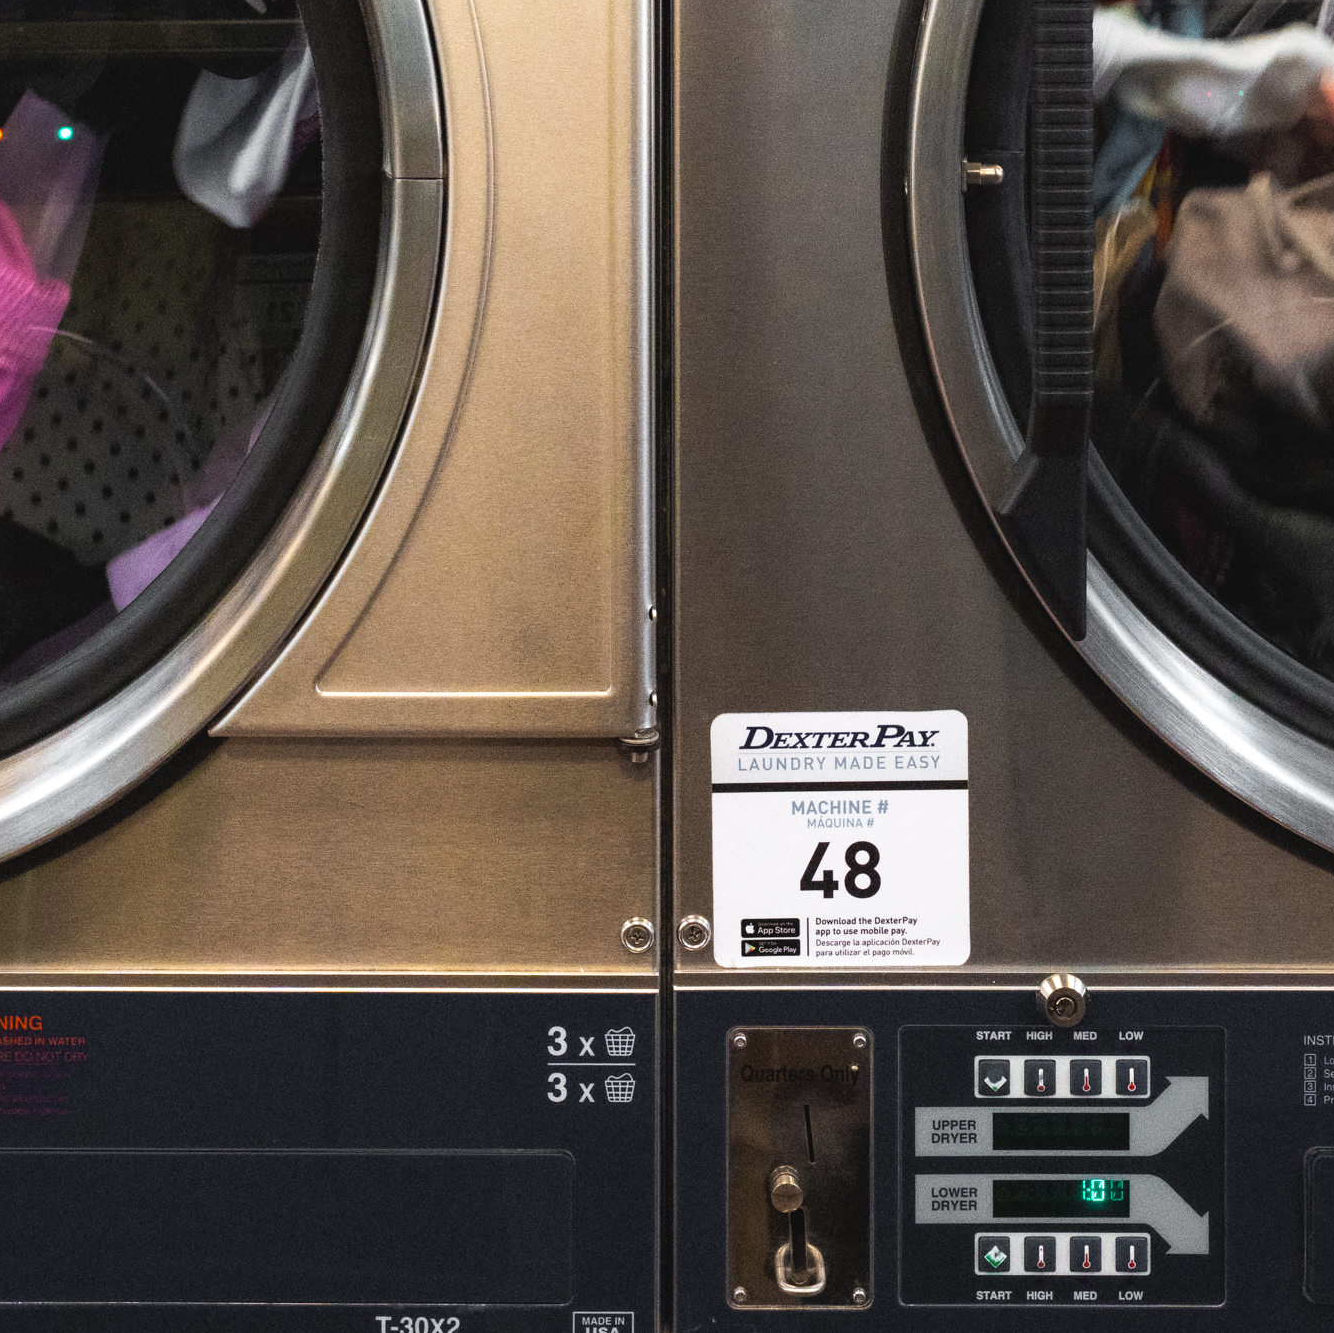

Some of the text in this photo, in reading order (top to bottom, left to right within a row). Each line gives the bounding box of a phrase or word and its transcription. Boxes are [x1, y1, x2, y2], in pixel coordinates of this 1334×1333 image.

[738, 755, 940, 771] LAUNDRY MADE EASY
[791, 799, 889, 815] MACHINE #
[807, 816, 863, 829] MÁQUINA
[800, 841, 881, 899] 48
[815, 916, 918, 927] Download the DexterPay
[757, 926, 796, 935] App Store
[815, 929, 831, 937] app
[860, 926, 889, 935] mobile
[890, 928, 908, 937] pay.
[815, 937, 940, 948] Descarge la aplicación DexterPay
[758, 945, 797, 955] Google Play
[834, 948, 861, 956] utilizar
[863, 948, 870, 956] el
[872, 949, 891, 958] pago
[34, 1036, 46, 1046] IN
[48, 1036, 85, 1046] WATER
[547, 1026, 568, 1056] 3
[976, 1031, 1144, 1041] START HIGH MED LOW
[740, 1064, 860, 1086] Quarters Only
[547, 1072, 568, 1103] 3
[931, 1120, 977, 1131] UPPER
[931, 1132, 978, 1144] DRYER
[931, 1187, 978, 1198] LOWER
[931, 1200, 978, 1211] DRYER
[976, 1291, 1144, 1301] START HIGH MED LOW
[375, 1316, 460, 1333] T-30X2
[582, 1316, 625, 1326] MADE IN
